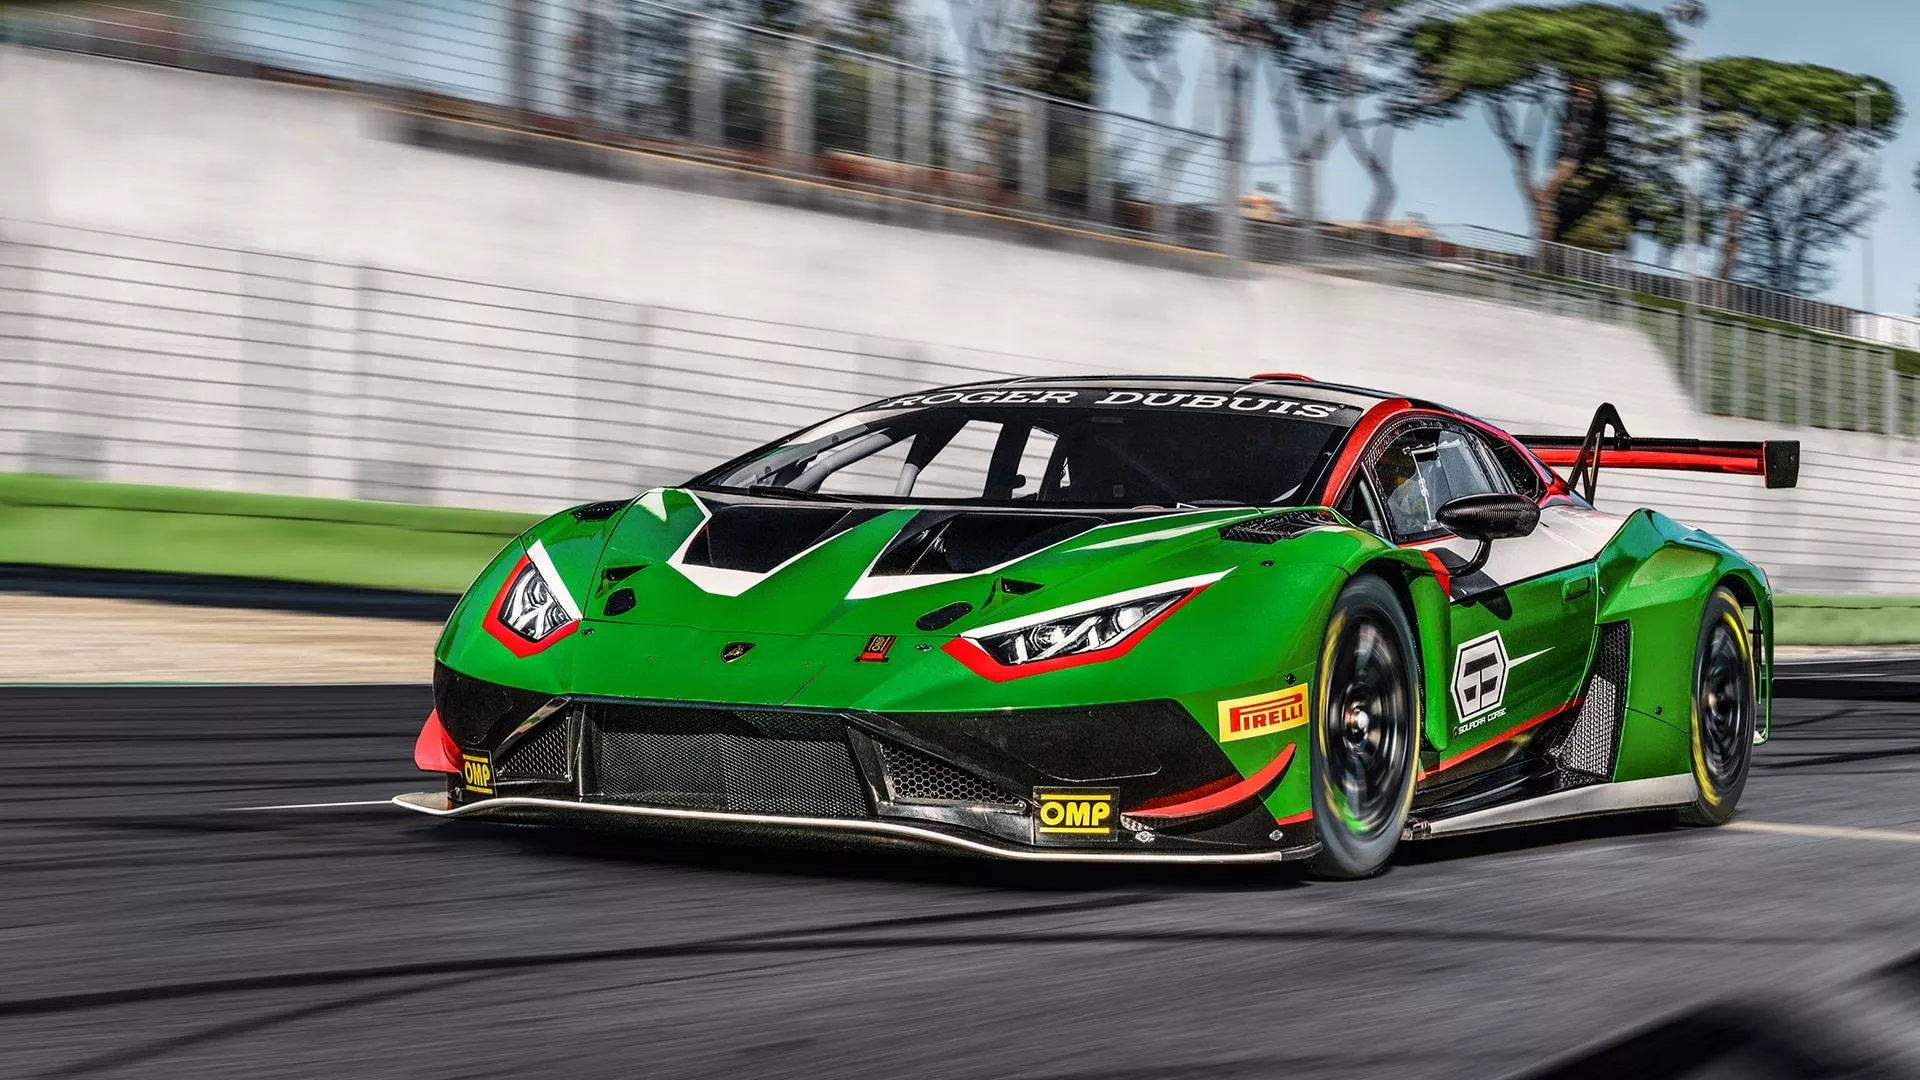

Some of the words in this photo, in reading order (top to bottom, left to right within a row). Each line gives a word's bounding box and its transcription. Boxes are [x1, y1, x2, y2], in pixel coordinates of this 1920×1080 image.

[877, 390, 1079, 409] ROGER
[1094, 390, 1337, 419] DUBUIS
[1229, 692, 1304, 733] PIRELLI
[464, 760, 491, 787] OMP
[1039, 801, 1111, 827] OMP
